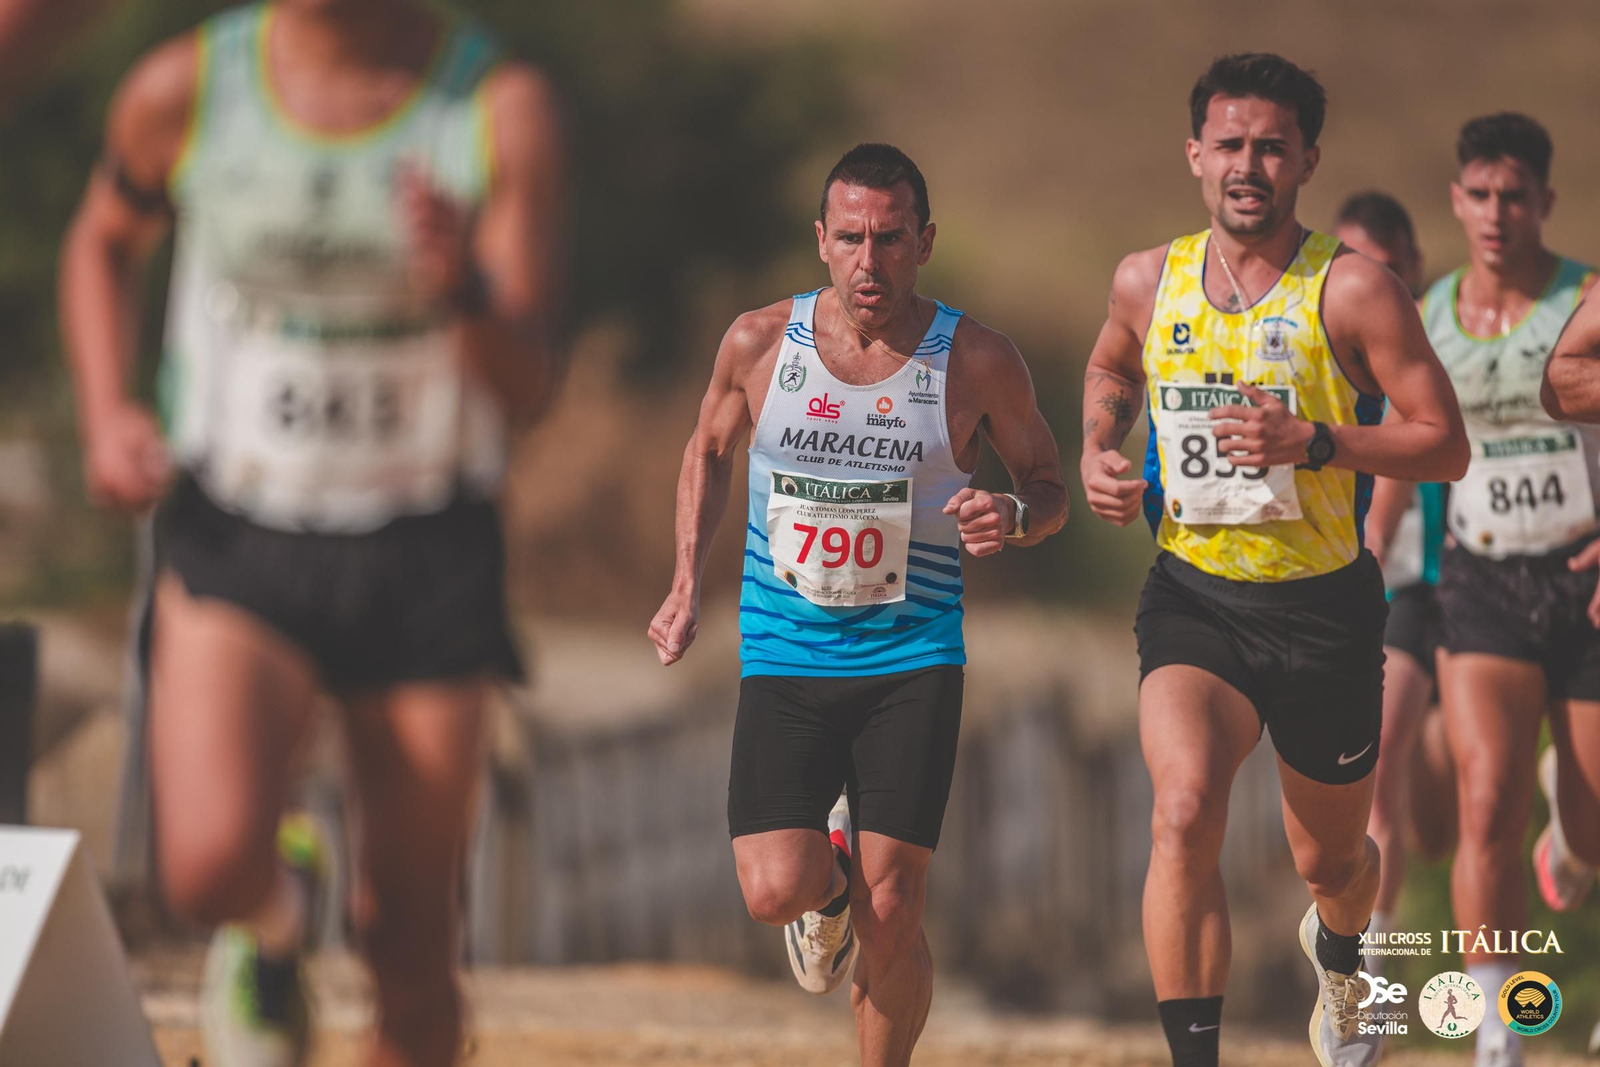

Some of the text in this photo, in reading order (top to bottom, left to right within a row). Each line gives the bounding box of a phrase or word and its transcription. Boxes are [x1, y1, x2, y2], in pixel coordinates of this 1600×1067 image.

[866, 416, 907, 429] mayfo
[780, 427, 923, 462] MARACENA
[796, 454, 906, 473] CLUB DE ATLETISMO
[805, 482, 871, 500] ITÁLICA
[1489, 474, 1565, 514] 844
[796, 510, 811, 518] CLUB
[811, 511, 849, 520] ATLETISMO
[799, 503, 815, 512] JUAN
[793, 522, 884, 569] 790
